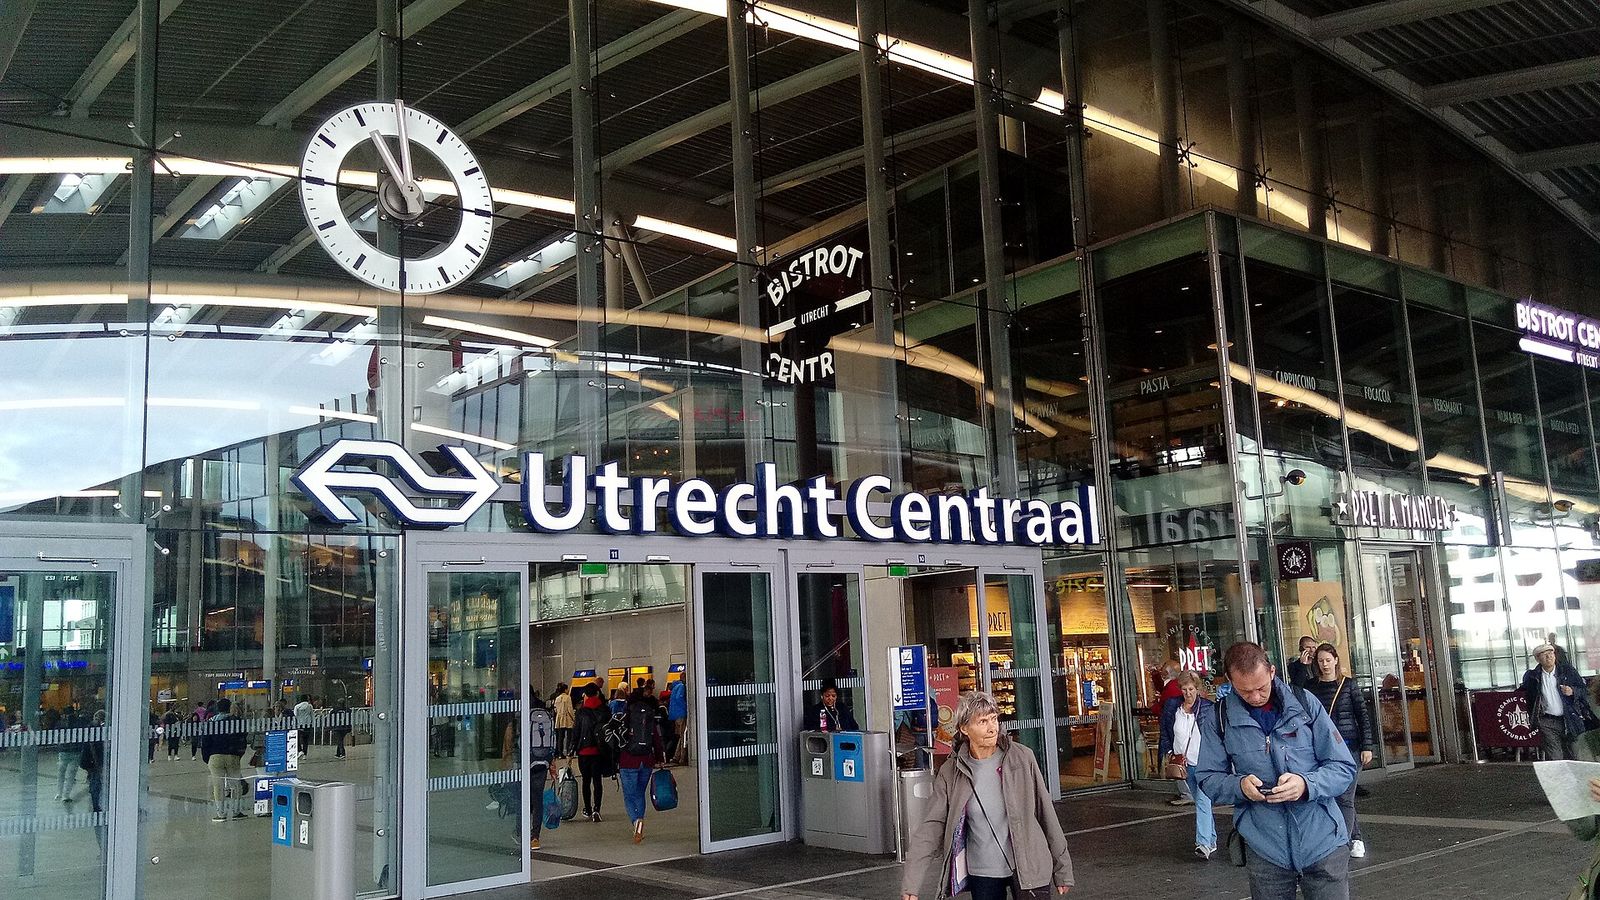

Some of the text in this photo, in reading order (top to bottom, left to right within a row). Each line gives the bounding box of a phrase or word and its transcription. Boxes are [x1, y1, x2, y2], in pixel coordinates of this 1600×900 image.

[767, 245, 864, 307] BISTROT
[801, 304, 829, 325] UTRECHT
[1516, 302, 1575, 343] BISTROT
[766, 352, 835, 384] CENTR
[1576, 352, 1599, 368] UTRECHT
[1140, 375, 1170, 395] PASTA
[1275, 370, 1317, 391] CAPPUCCINO
[1364, 386, 1392, 404] FOCACCIA
[521, 452, 1101, 546] Utrecht Centraal
[1351, 490, 1452, 530] PRET A MANGER
[611, 551, 618, 559] 11
[988, 612, 1007, 631] PRET
[1178, 646, 1209, 671] PRET
[1496, 696, 1518, 717] ORGANIC
[1499, 724, 1528, 741] NATURAL
